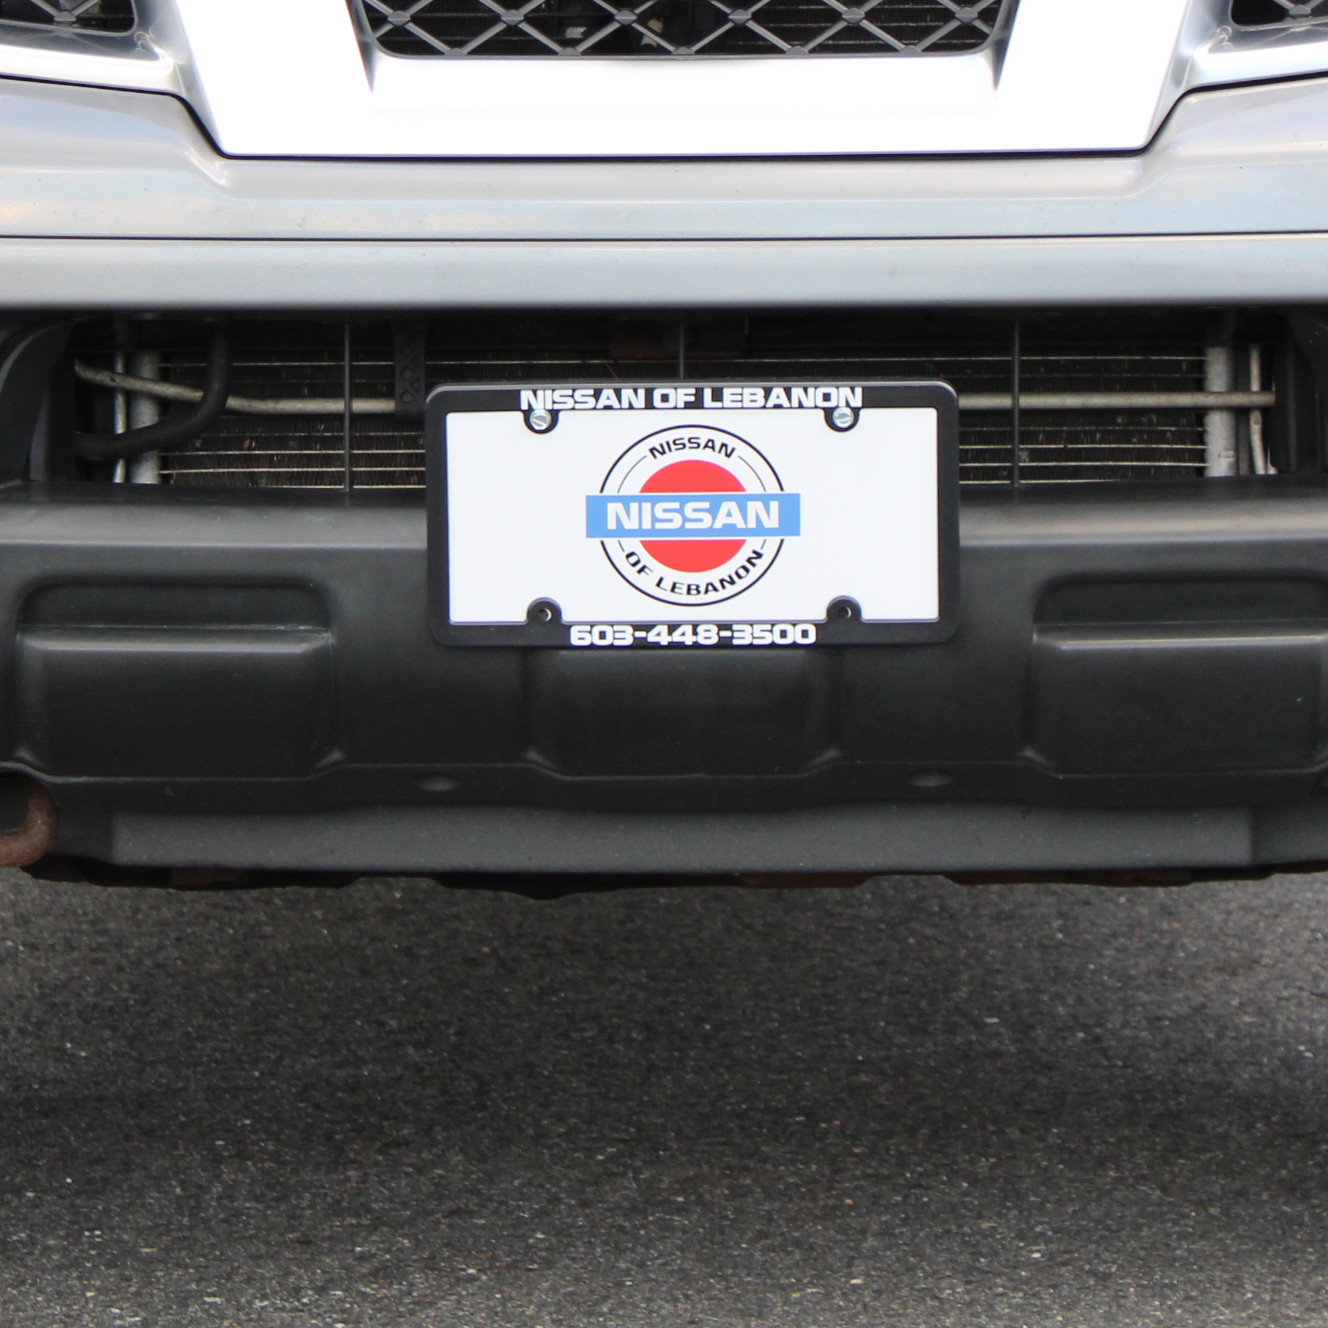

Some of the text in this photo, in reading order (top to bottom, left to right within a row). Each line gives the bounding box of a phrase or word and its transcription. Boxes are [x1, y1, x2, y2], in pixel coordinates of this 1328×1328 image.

[520, 386, 863, 410] NISSAN OF LEBANON
[648, 436, 736, 460] NISSAN
[606, 500, 780, 530] NISSAN
[625, 549, 764, 597] OF LEBANON
[569, 623, 817, 647] 603-448-3500
